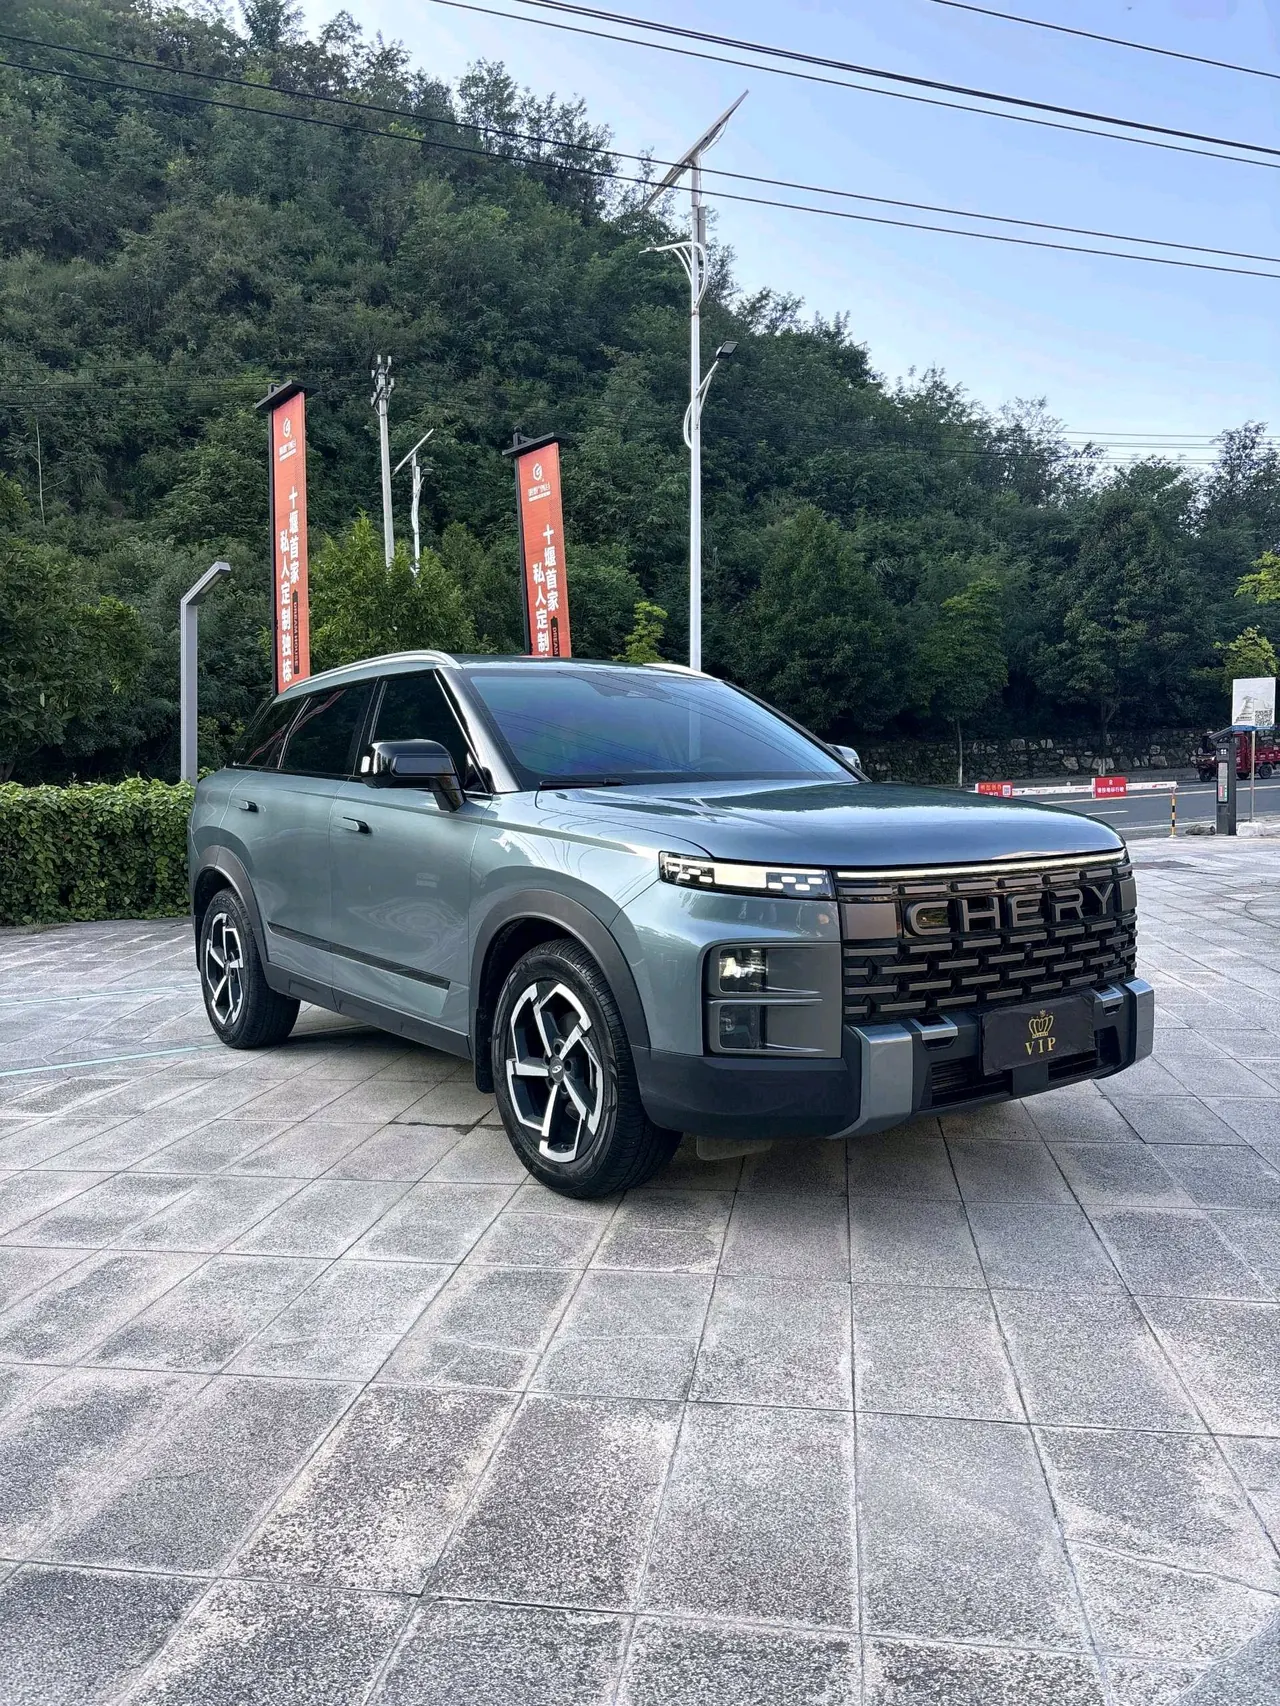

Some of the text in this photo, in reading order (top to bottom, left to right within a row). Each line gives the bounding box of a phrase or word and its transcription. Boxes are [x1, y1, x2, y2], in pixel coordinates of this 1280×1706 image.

[288, 486, 300, 586] 十堰首家
[543, 523, 559, 612] 十堰首家
[533, 562, 550, 656] 私人定制
[905, 883, 1114, 937] CHERY
[1024, 1036, 1056, 1056] VIP
